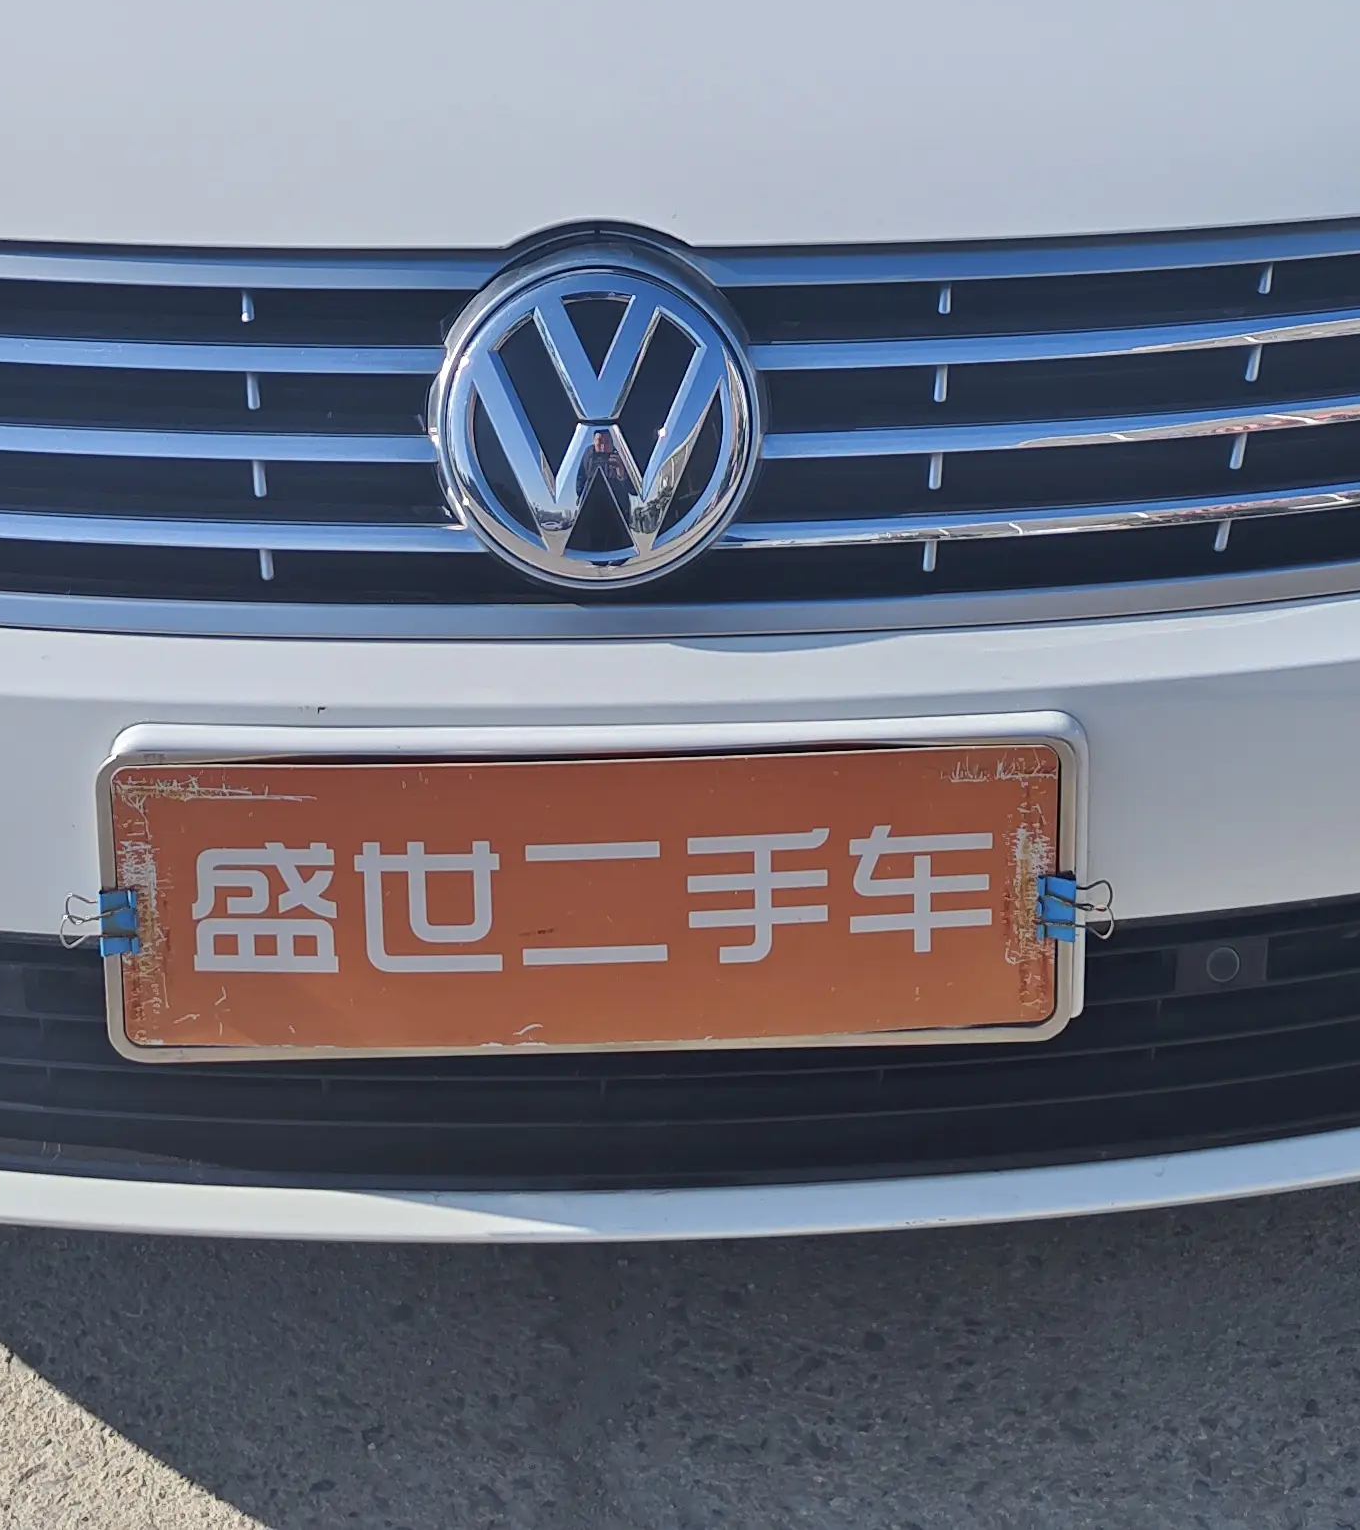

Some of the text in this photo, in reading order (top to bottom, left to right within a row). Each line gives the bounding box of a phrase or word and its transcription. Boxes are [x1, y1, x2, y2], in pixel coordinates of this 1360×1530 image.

[193, 827, 993, 972] 盛世二手车
